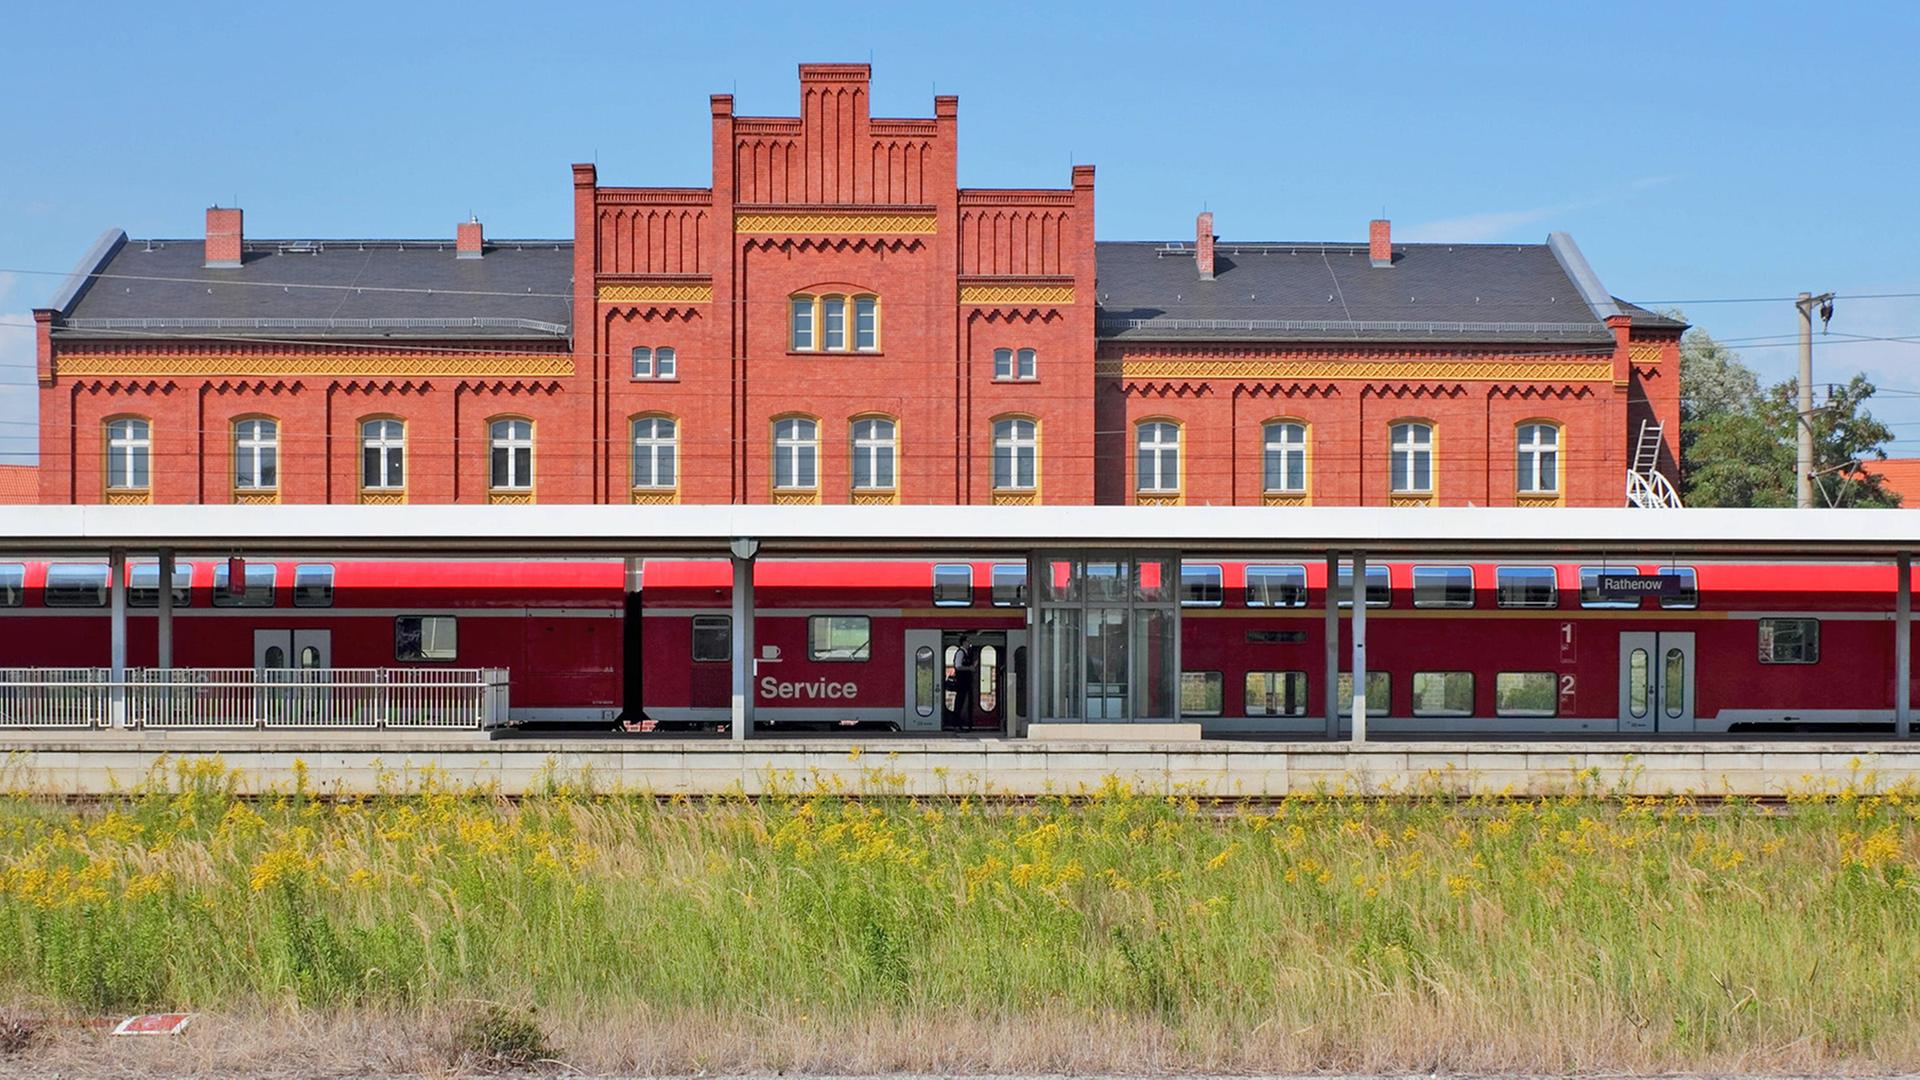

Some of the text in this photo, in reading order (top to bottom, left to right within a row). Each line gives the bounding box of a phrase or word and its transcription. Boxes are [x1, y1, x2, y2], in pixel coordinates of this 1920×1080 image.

[1604, 578, 1663, 590] Rathenow
[1562, 624, 1571, 643] 1
[761, 677, 858, 699] Service
[1561, 675, 1575, 694] 2
